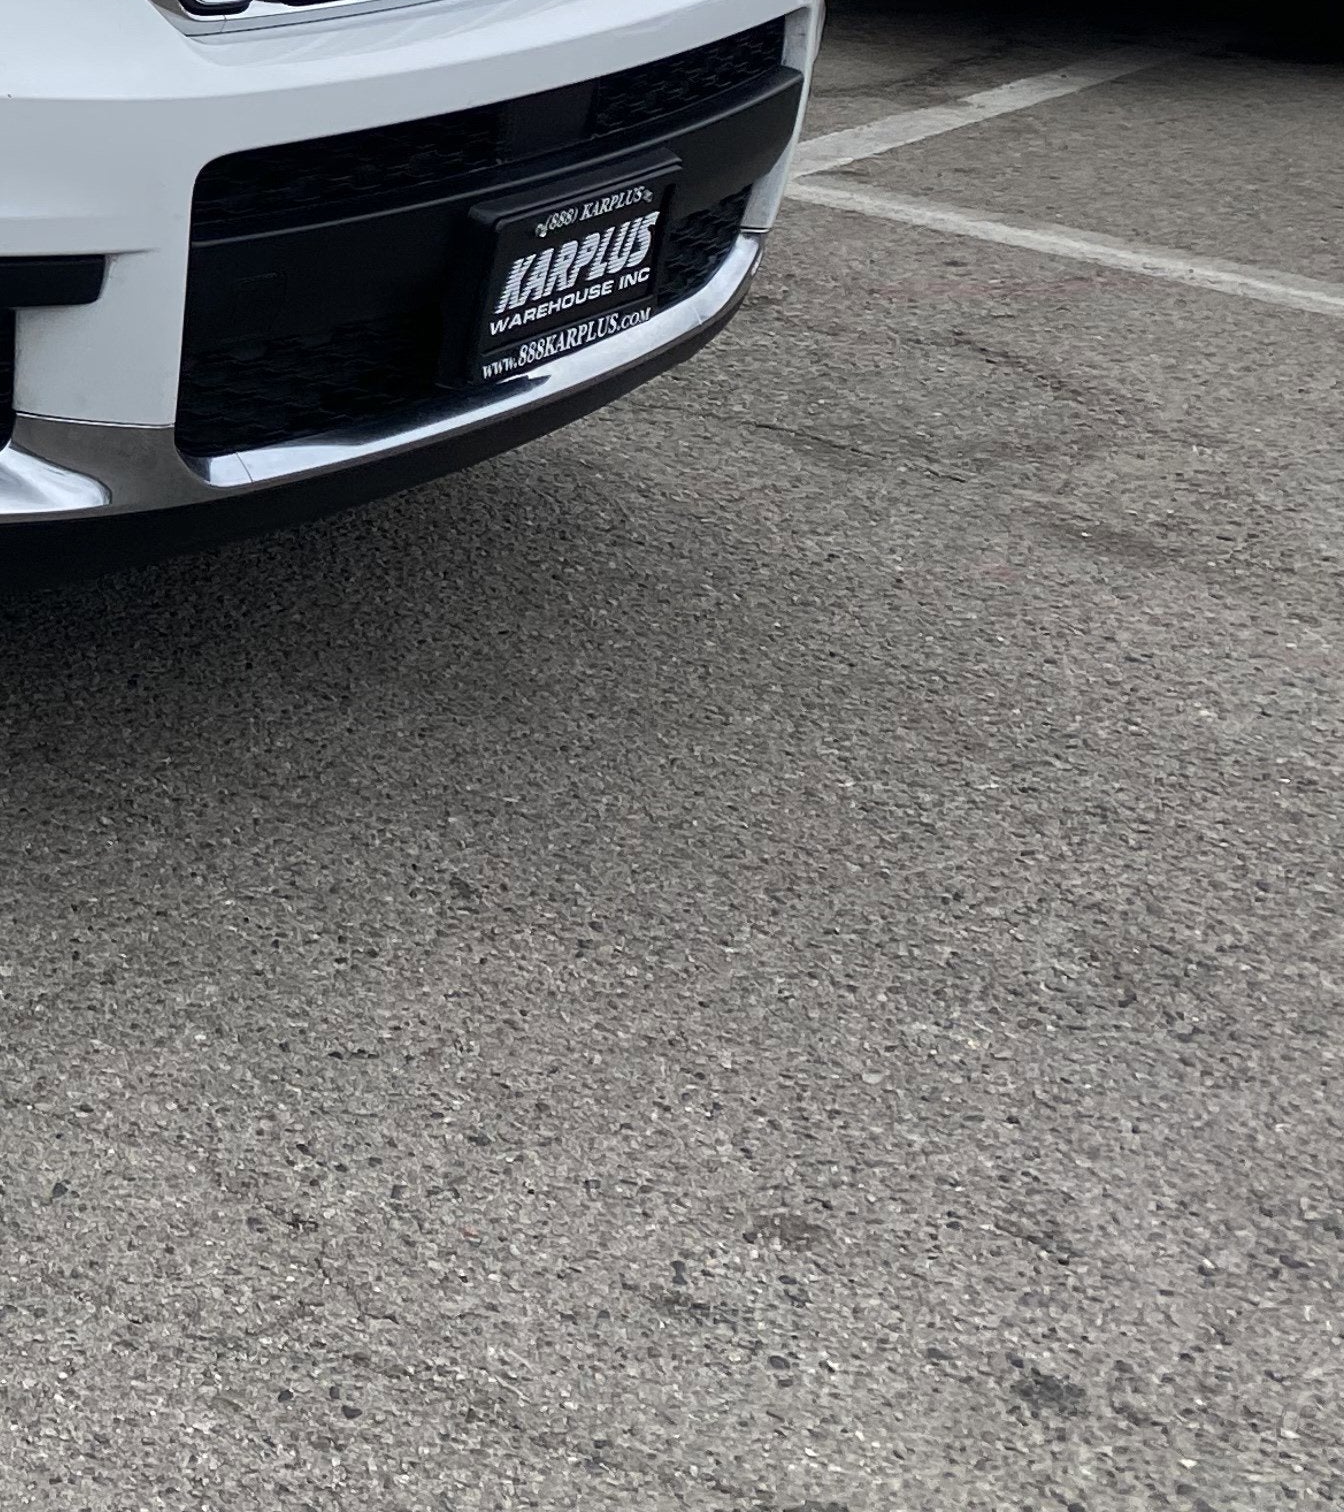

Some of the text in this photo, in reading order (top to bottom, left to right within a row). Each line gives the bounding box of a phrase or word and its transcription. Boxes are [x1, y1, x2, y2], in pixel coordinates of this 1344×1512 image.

[578, 185, 646, 222] KARPLUS
[494, 210, 661, 315] KARPLUS
[489, 266, 651, 336] WAREHOUSE INC
